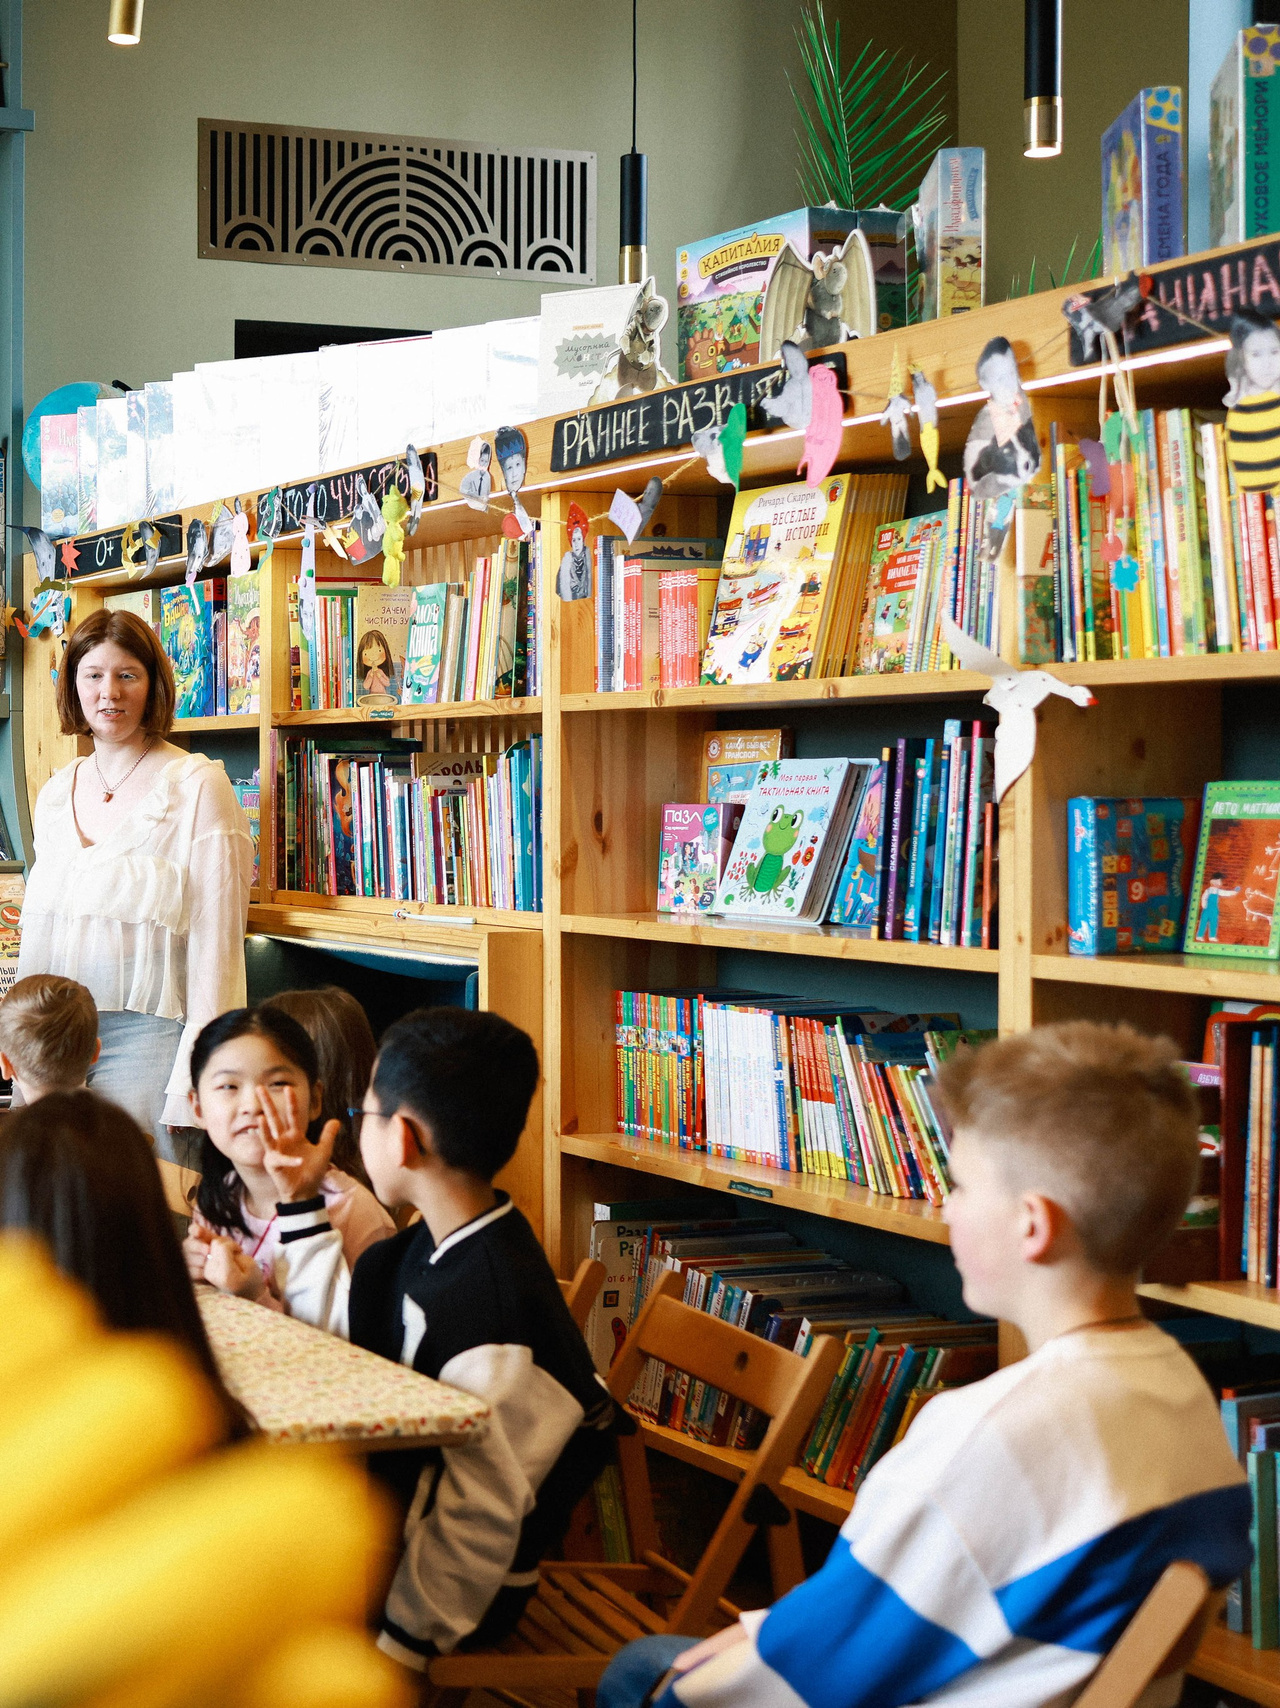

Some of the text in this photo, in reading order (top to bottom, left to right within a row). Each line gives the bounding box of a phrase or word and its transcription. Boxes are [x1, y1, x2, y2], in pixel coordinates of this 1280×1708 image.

[1253, 159, 1269, 238] УКОВОЕ
[702, 239, 781, 273] КАПИТАЛИЯ
[562, 404, 651, 468] РАННЕЕ
[758, 491, 816, 508] Ричард Скарри
[784, 522, 830, 542] ИСТОРИИ
[381, 606, 407, 616] ЗАЧЕМ
[364, 616, 410, 627] ЧИСТИТЬ ЗУ
[778, 773, 817, 783] Моя первая
[759, 785, 830, 797] ТАКТИЛЬНАЯ КНИГА
[893, 788, 902, 813] НОЧЬ
[889, 835, 899, 872] СКАЗКИ
